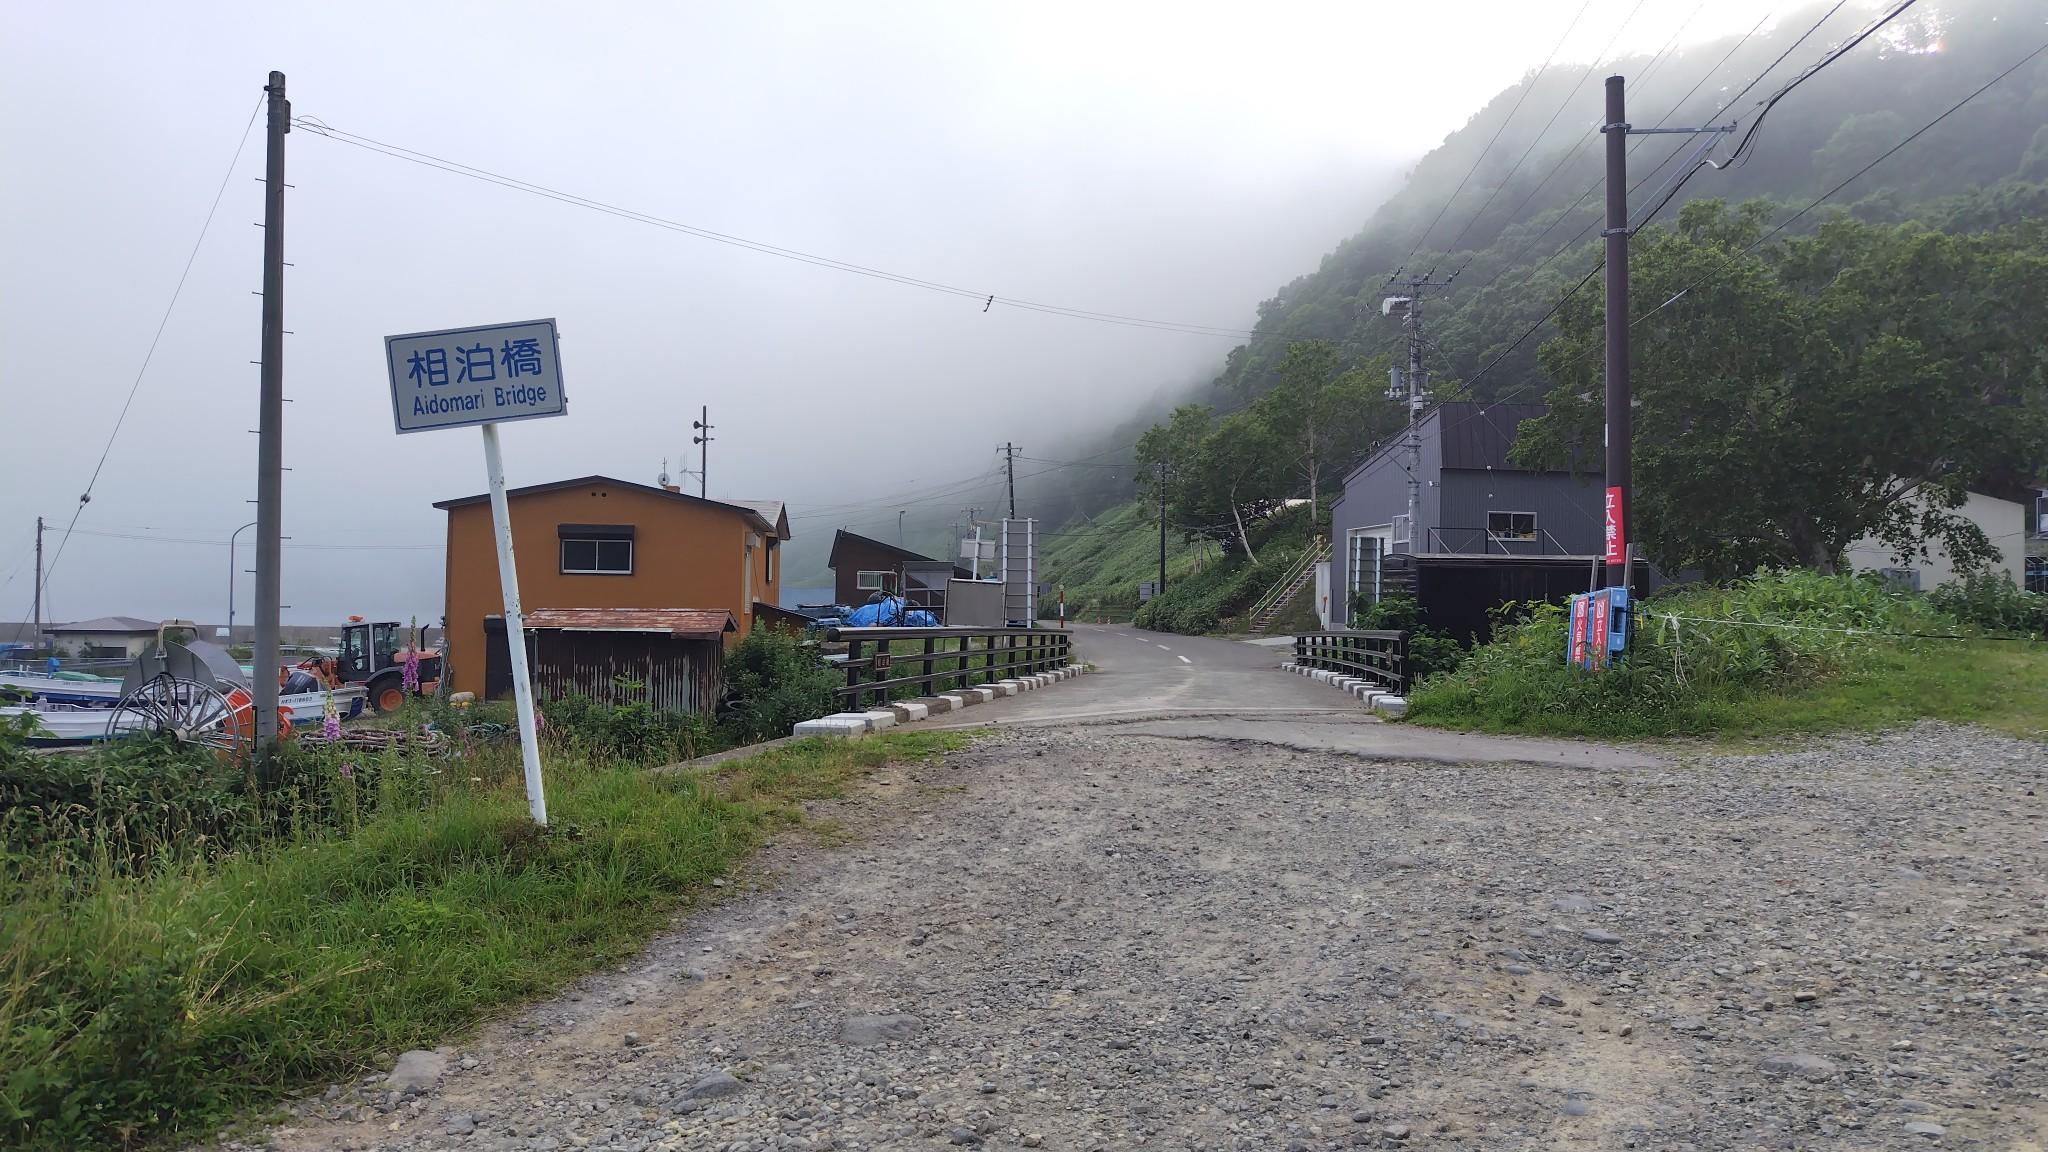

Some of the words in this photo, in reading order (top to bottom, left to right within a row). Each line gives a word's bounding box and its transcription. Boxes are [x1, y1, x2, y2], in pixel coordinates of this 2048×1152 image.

[406, 338, 543, 388] 相泊橋
[413, 389, 485, 416] Aidomari
[495, 384, 547, 407] Bridge
[1606, 492, 1618, 556] 立入禁止
